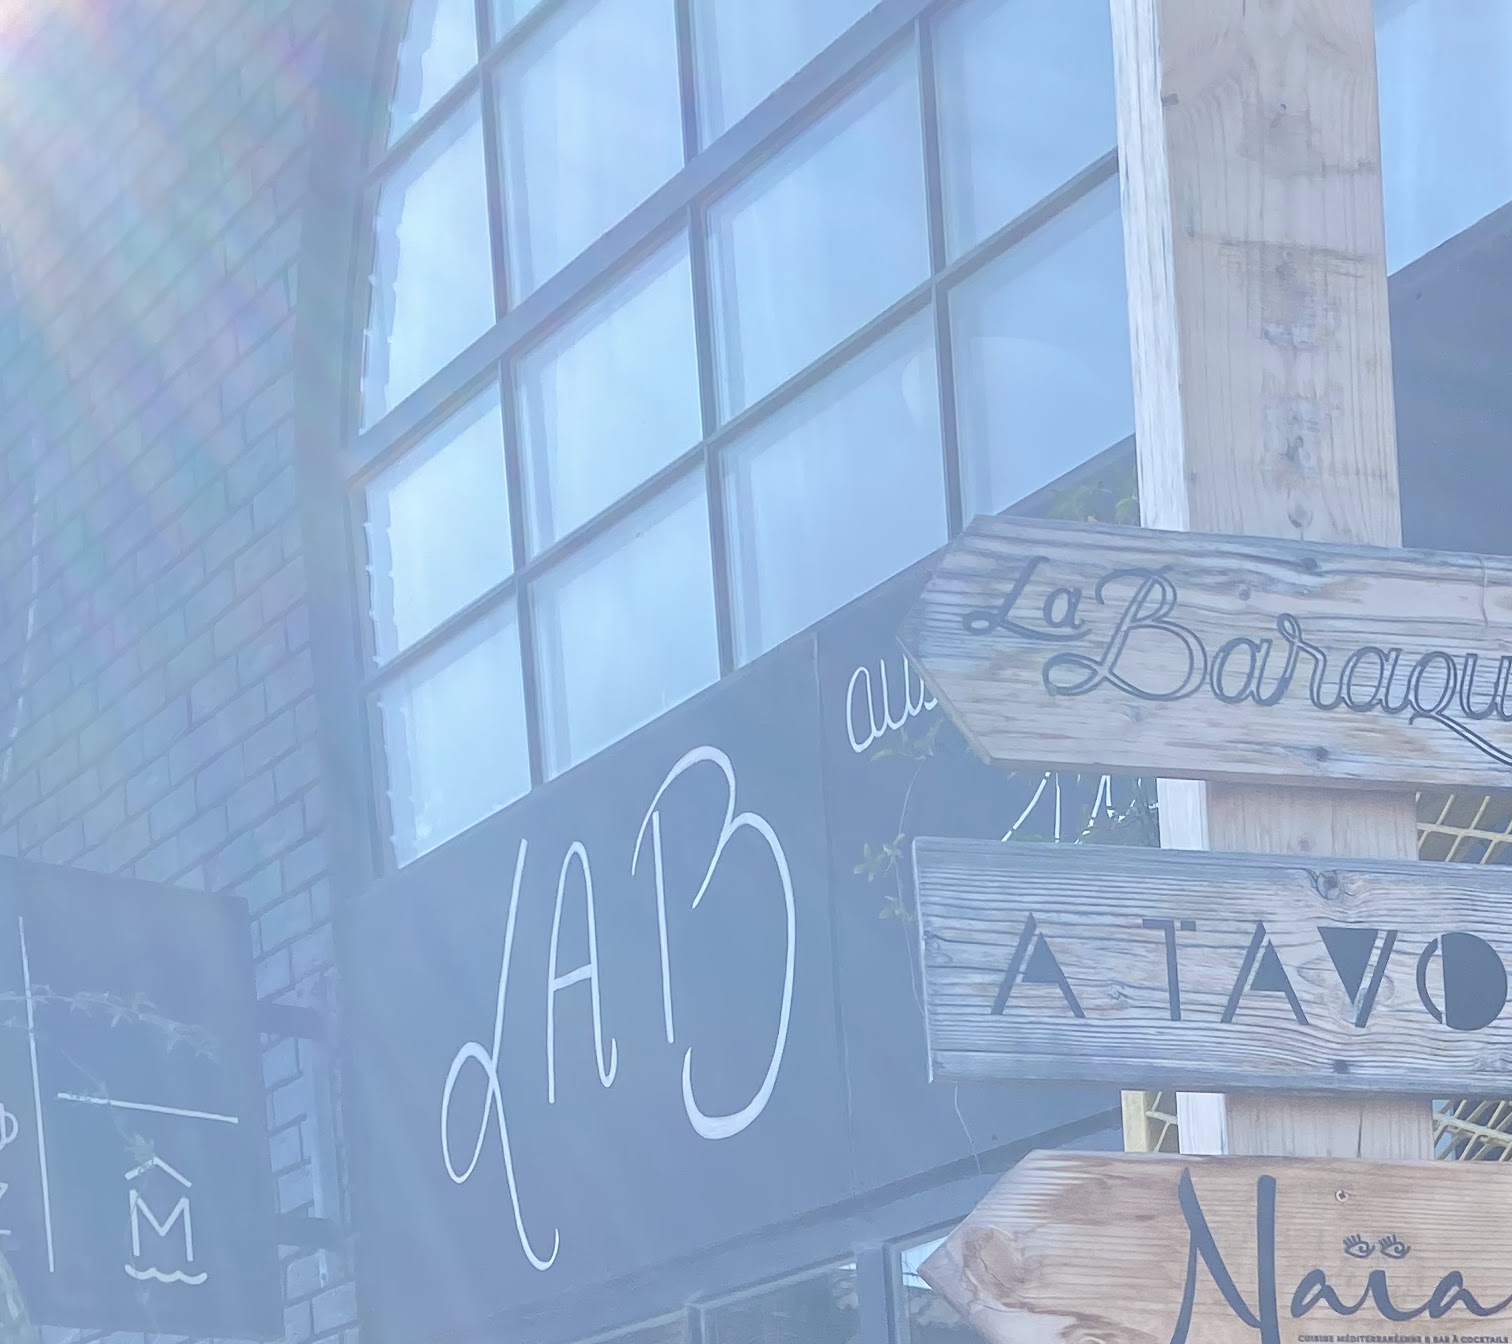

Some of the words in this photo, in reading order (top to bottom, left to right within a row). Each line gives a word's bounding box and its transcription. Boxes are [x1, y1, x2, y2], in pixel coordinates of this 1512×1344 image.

[963, 556, 1091, 641] La
[991, 911, 1086, 1019] A
[1298, 1334, 1334, 1343] CUISINE
[1433, 1335, 1450, 1343] BAR
[1461, 1335, 1509, 1343] COCKTAILS
